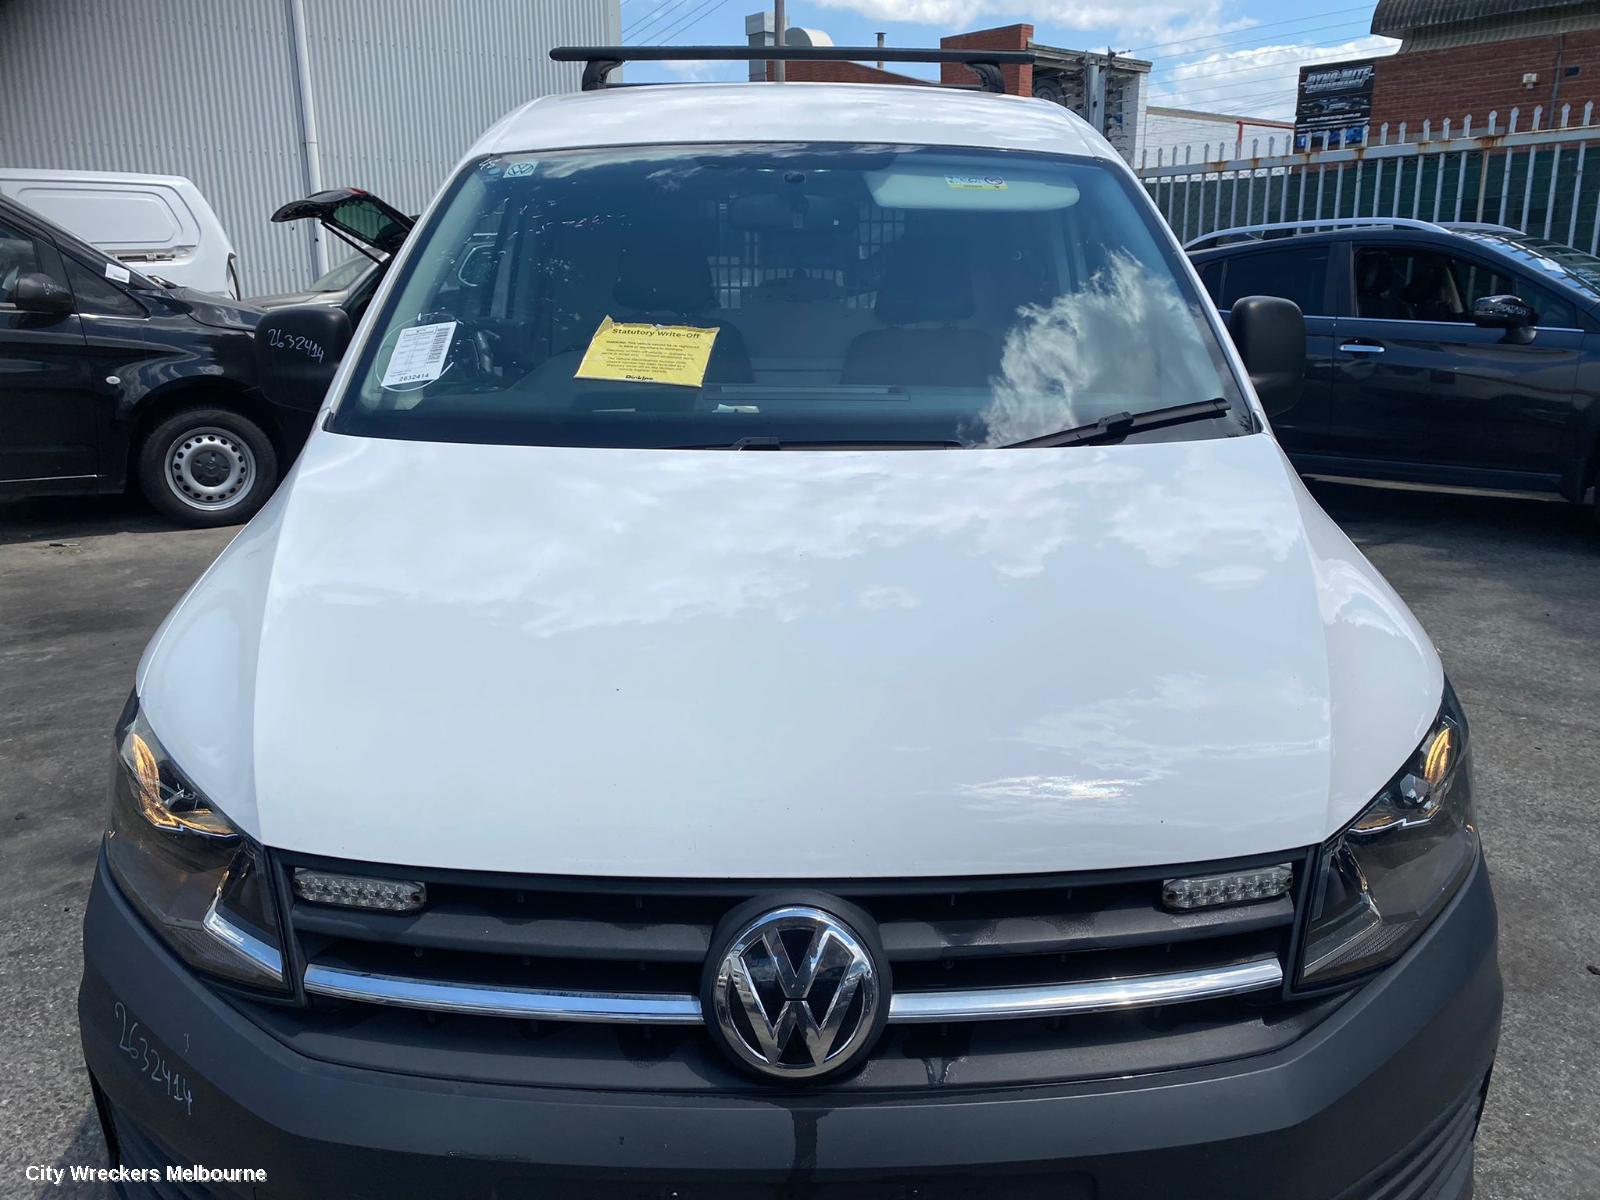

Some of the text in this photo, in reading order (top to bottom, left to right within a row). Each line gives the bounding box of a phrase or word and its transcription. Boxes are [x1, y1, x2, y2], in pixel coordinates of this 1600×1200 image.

[267, 328, 324, 364] 2632414
[612, 328, 701, 339] Statutory Write-Off
[115, 1002, 192, 1116] 2632414
